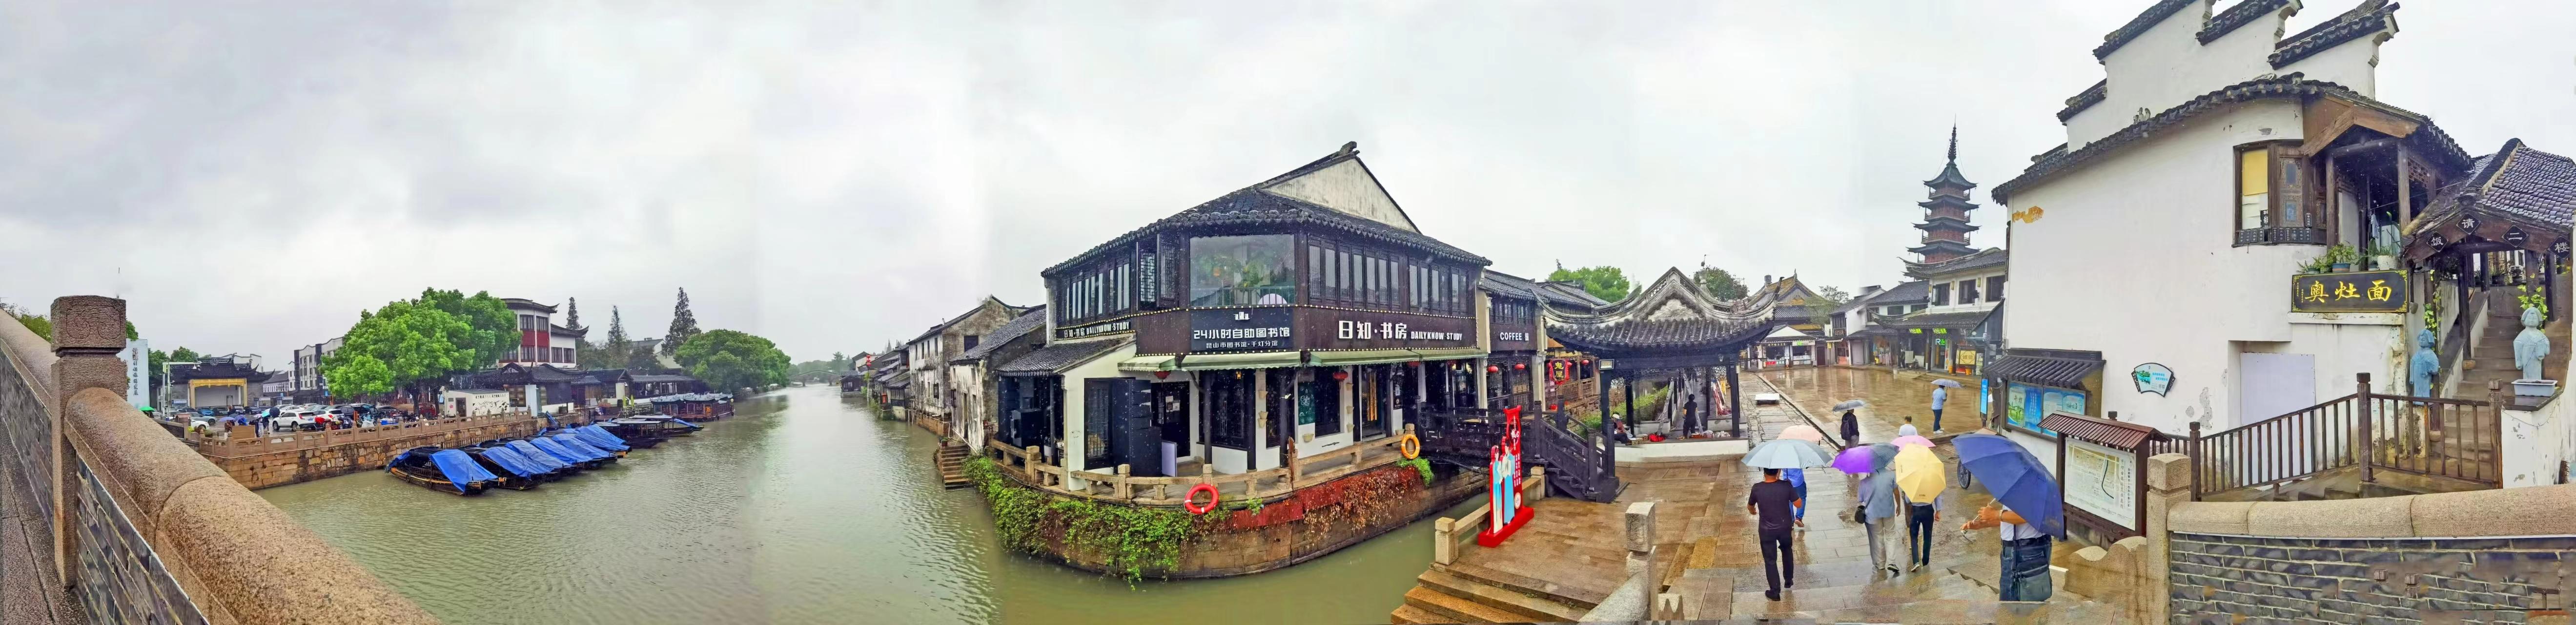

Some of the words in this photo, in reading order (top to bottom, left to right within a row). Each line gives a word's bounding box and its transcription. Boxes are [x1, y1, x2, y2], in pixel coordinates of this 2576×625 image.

[2305, 280, 2392, 303] 奥灶面
[1193, 327, 1290, 339] 24小时自助图书馆
[1500, 332, 1522, 340] COFFEE
